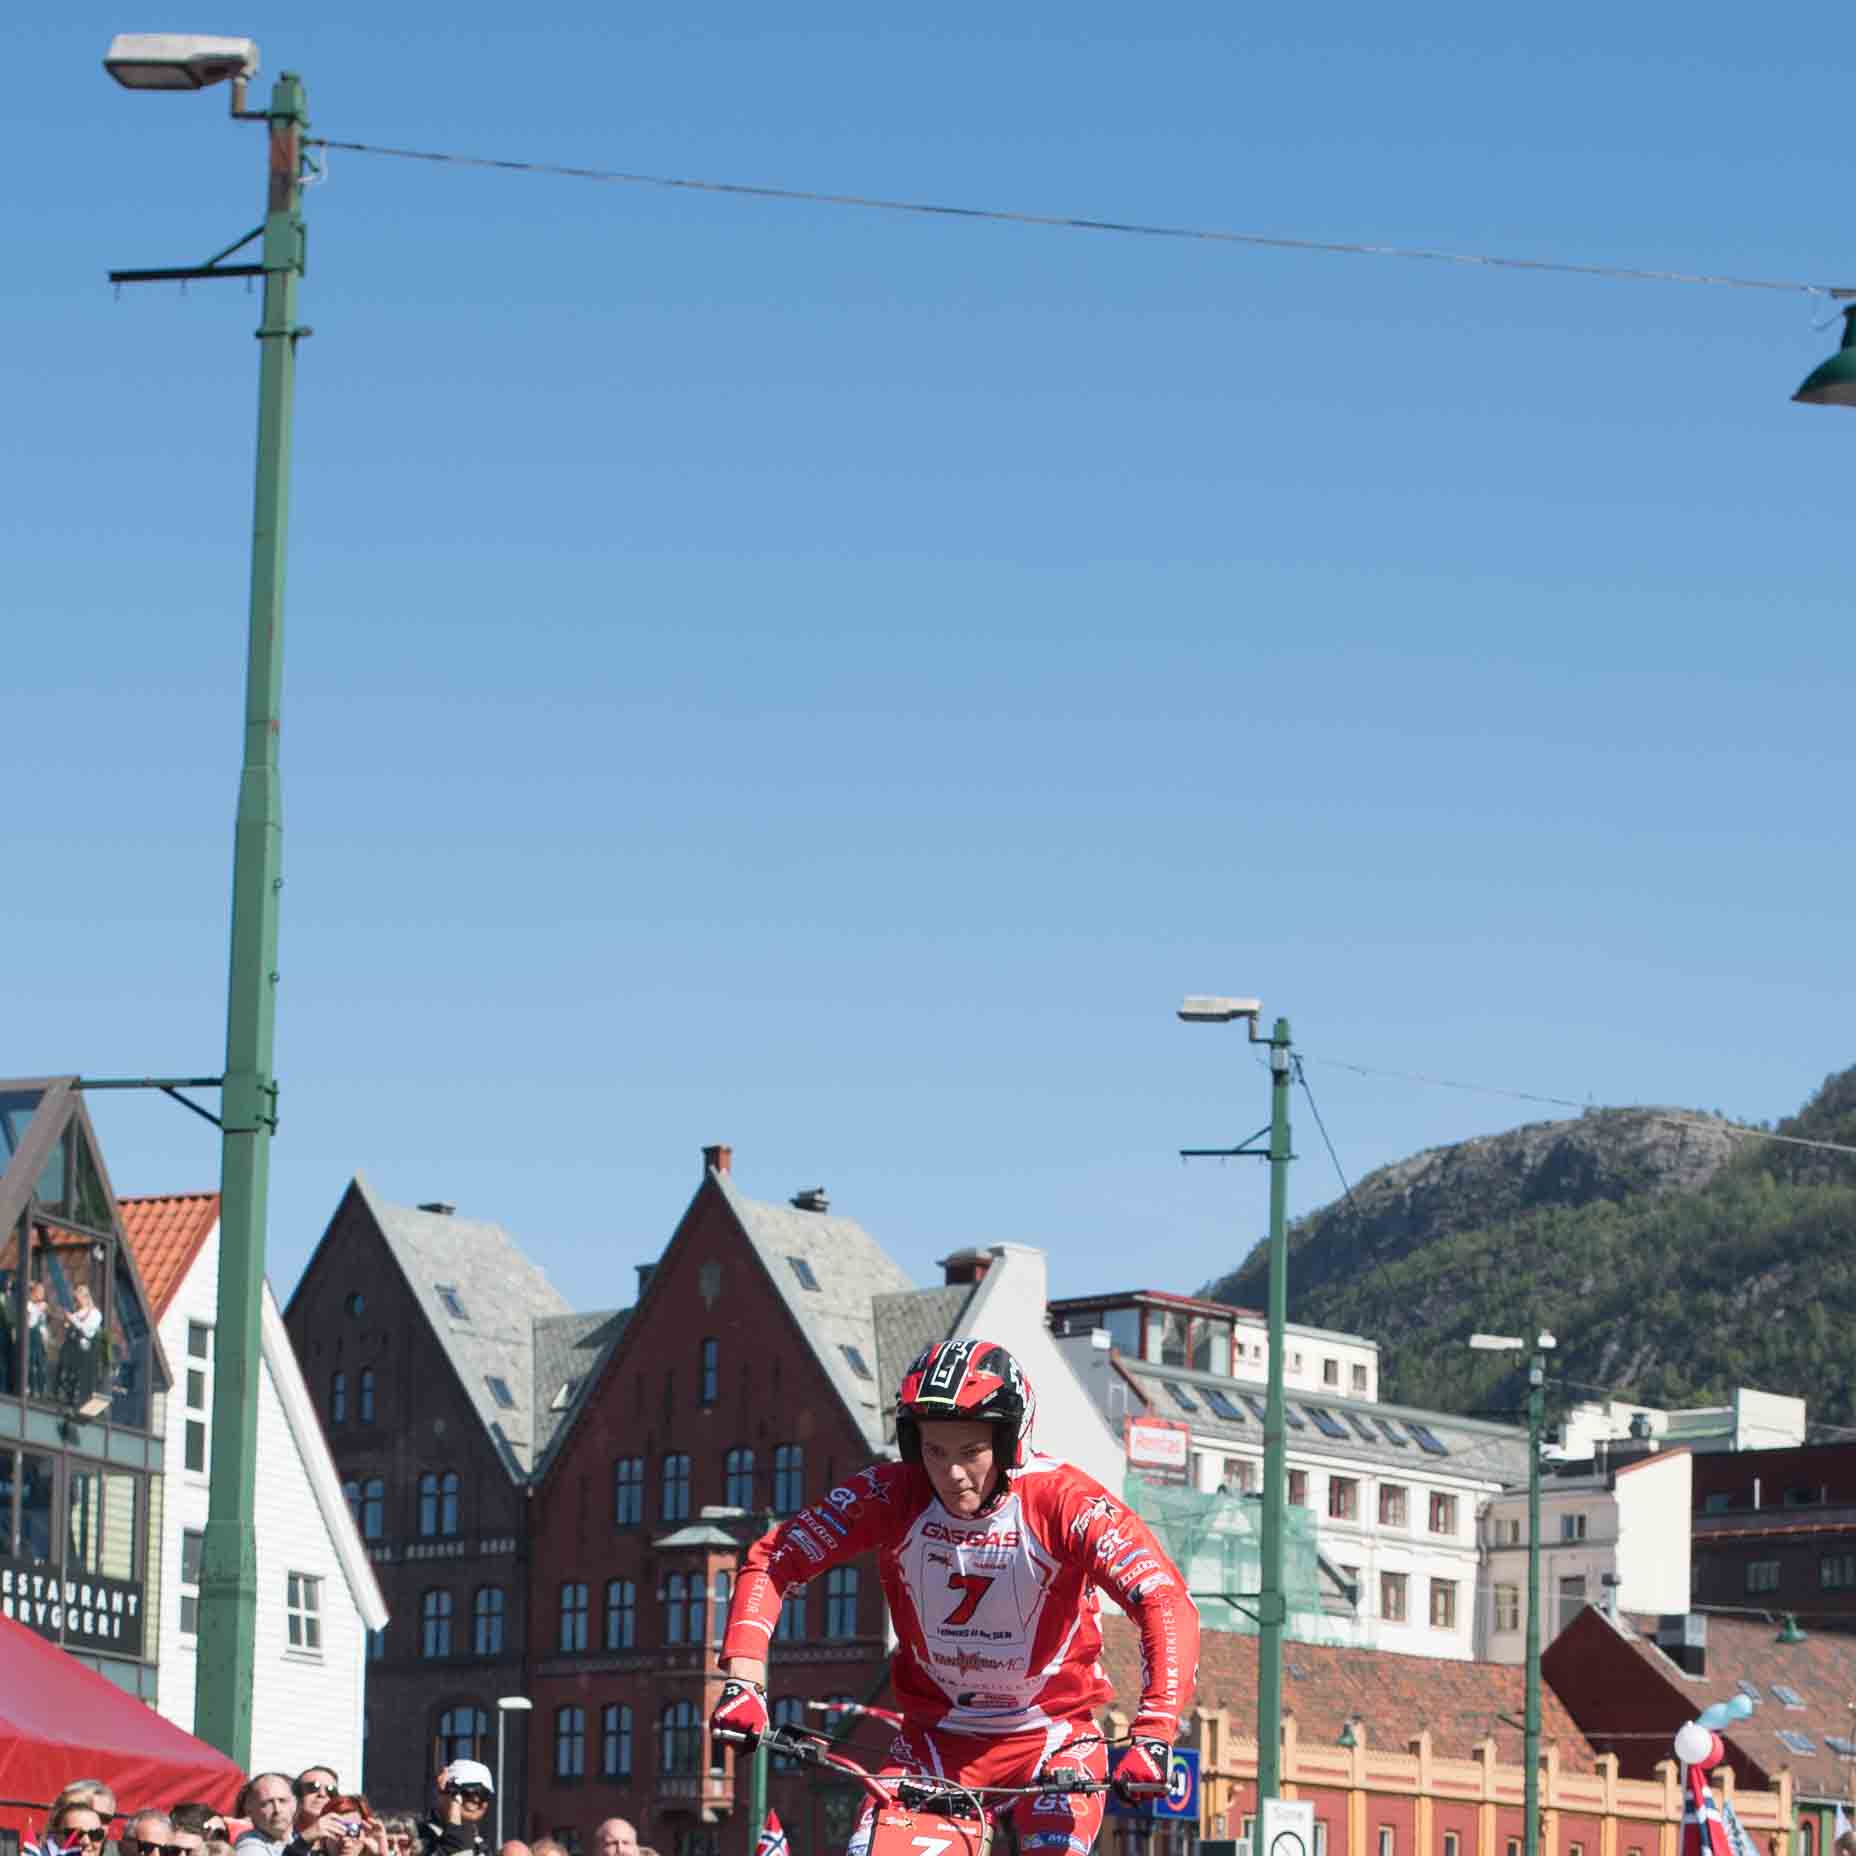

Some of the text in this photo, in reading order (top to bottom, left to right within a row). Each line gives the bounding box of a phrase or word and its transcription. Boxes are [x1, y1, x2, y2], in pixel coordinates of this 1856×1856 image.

[2, 1596, 121, 1639] BRYGGERI
[942, 1572, 996, 1626] 7
[1165, 1666, 1180, 1705] LINK
